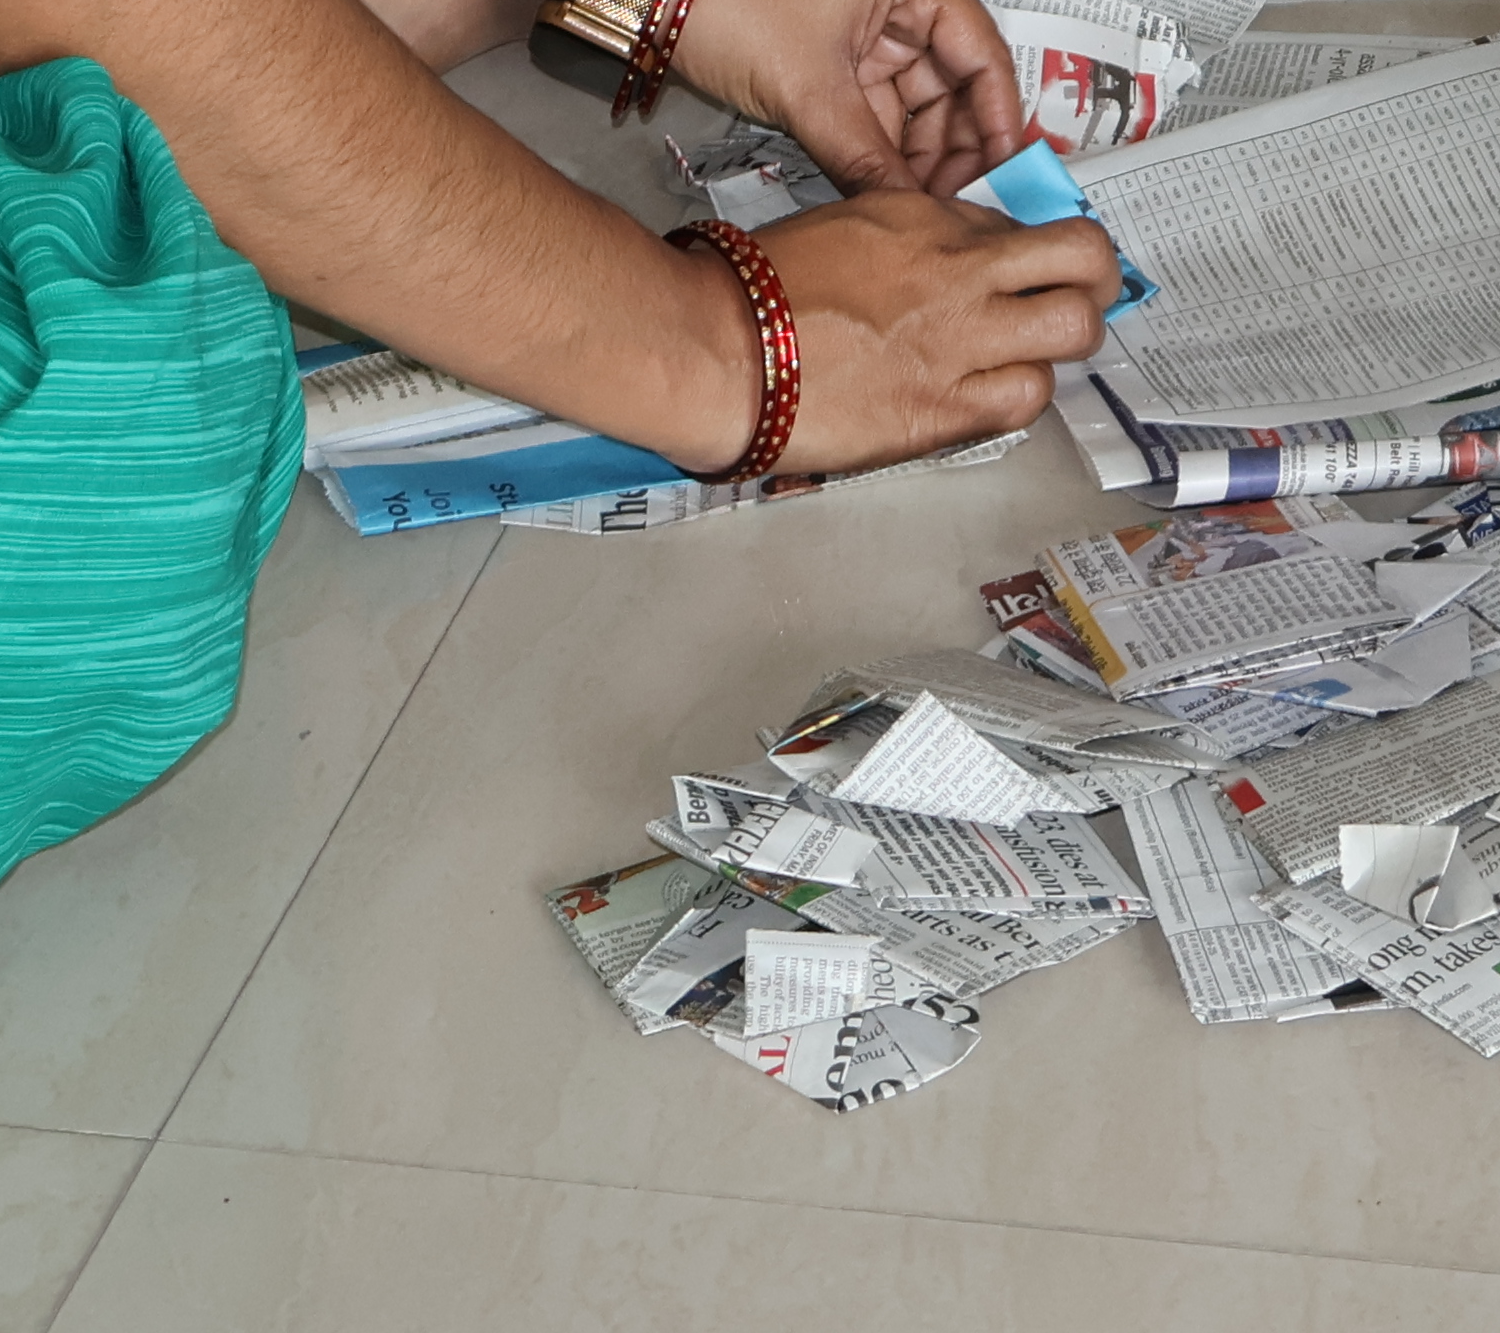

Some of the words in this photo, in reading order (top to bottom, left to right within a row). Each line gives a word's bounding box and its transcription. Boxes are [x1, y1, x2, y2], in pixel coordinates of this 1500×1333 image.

[1386, 441, 1406, 467] Belt
[895, 721, 940, 766] demand
[953, 740, 979, 765] once
[854, 744, 897, 786] military
[882, 760, 902, 780] for
[906, 746, 934, 775] whiff
[927, 761, 959, 793] called
[794, 828, 823, 861] FRIDAY,
[1046, 839, 1085, 871] dies
[1073, 871, 1107, 891] at
[957, 932, 996, 954] as
[789, 955, 799, 1013] measures
[816, 957, 828, 991] ments
[831, 959, 845, 981] ing
[759, 974, 772, 998] The
[801, 956, 814, 1018] providing
[757, 1003, 771, 1032] high
